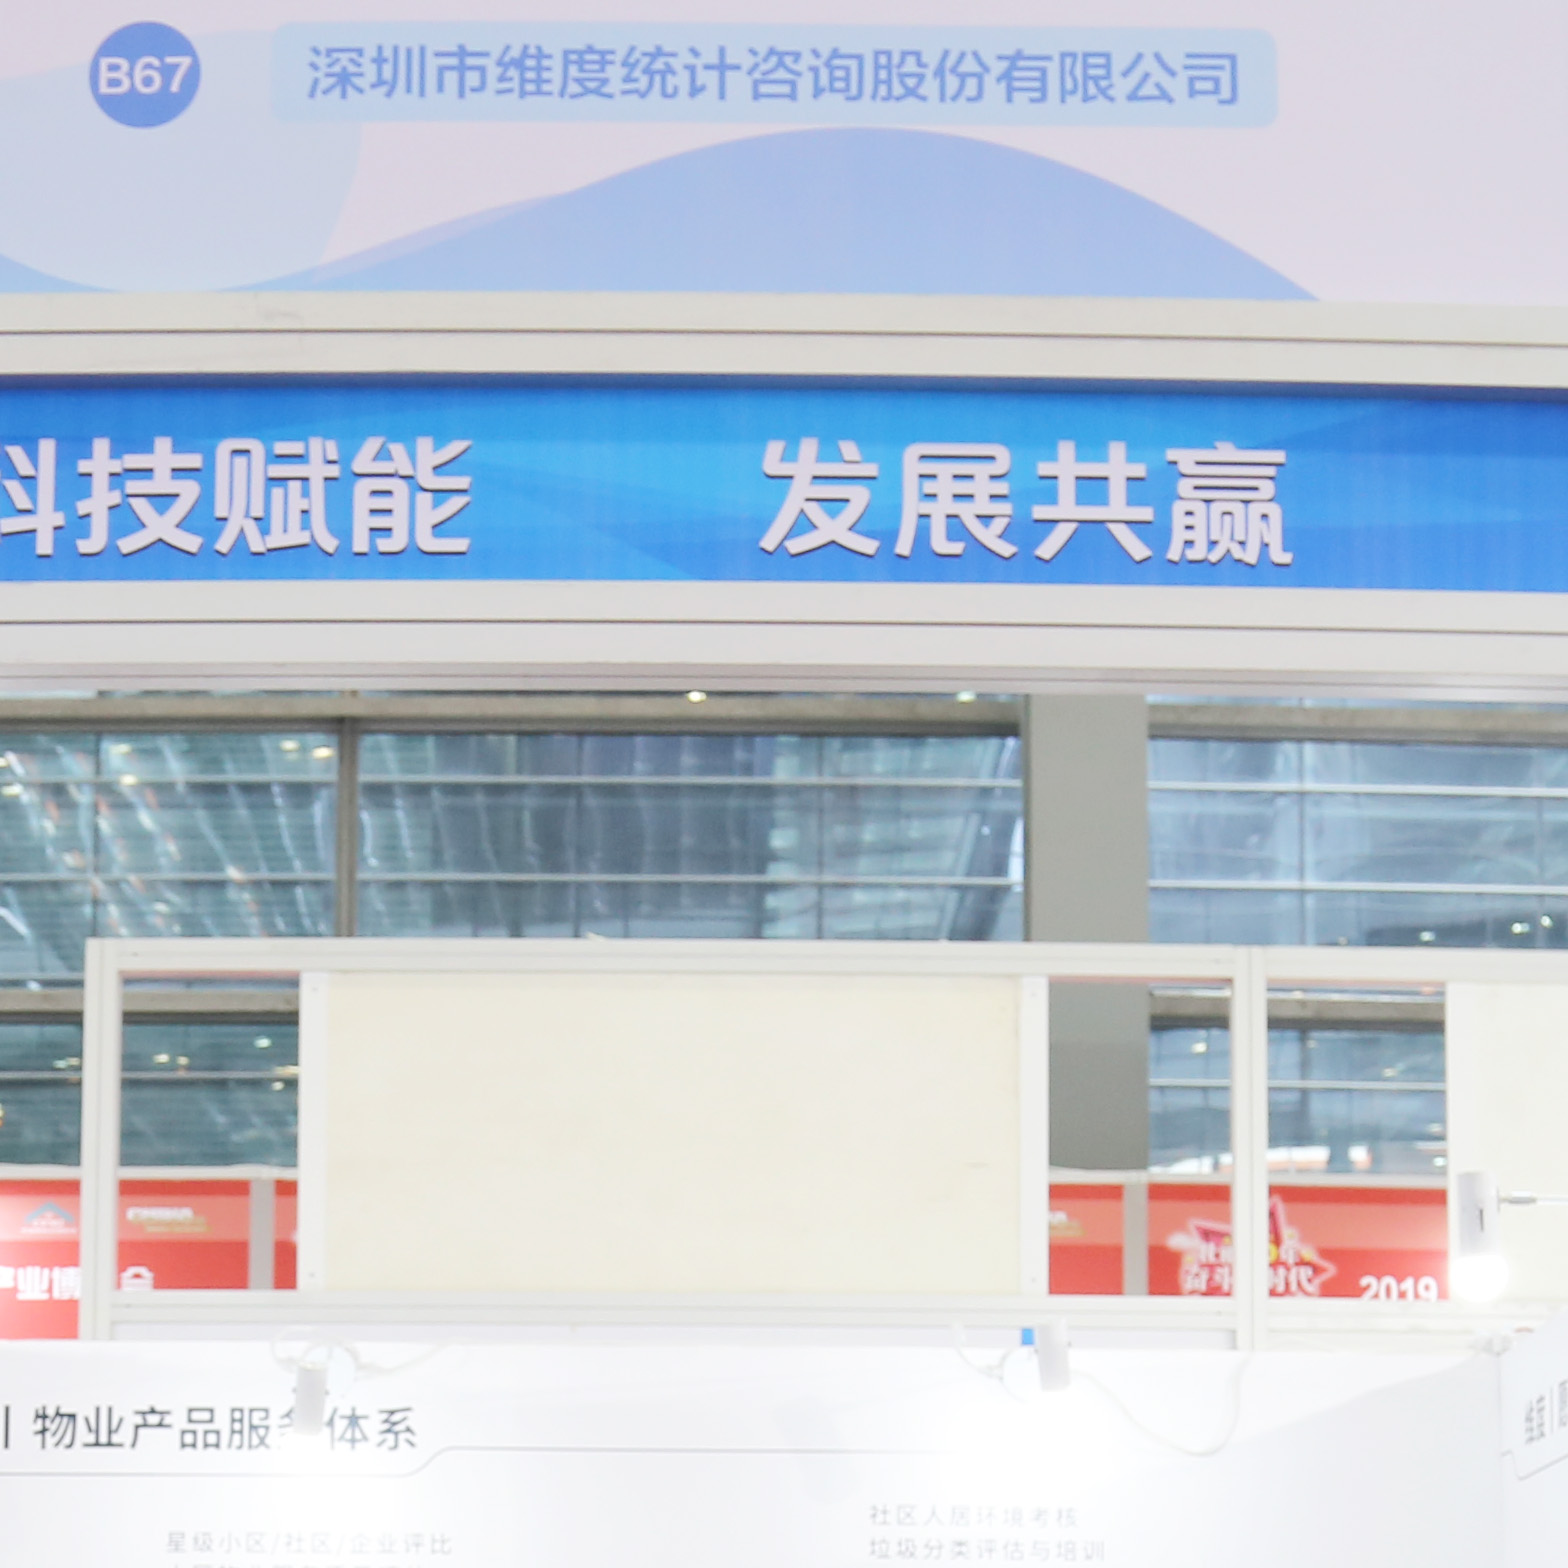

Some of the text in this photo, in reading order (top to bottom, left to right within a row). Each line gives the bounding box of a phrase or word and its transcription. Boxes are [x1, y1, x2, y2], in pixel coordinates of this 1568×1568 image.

[99, 56, 192, 97] B67
[305, 44, 1241, 109] 深圳市维度统计咨询股份有限公司
[759, 439, 1294, 569] 发展共赢
[1359, 1275, 1438, 1301] 2019
[868, 1538, 1106, 1562] 垃圾分类评估与培训
